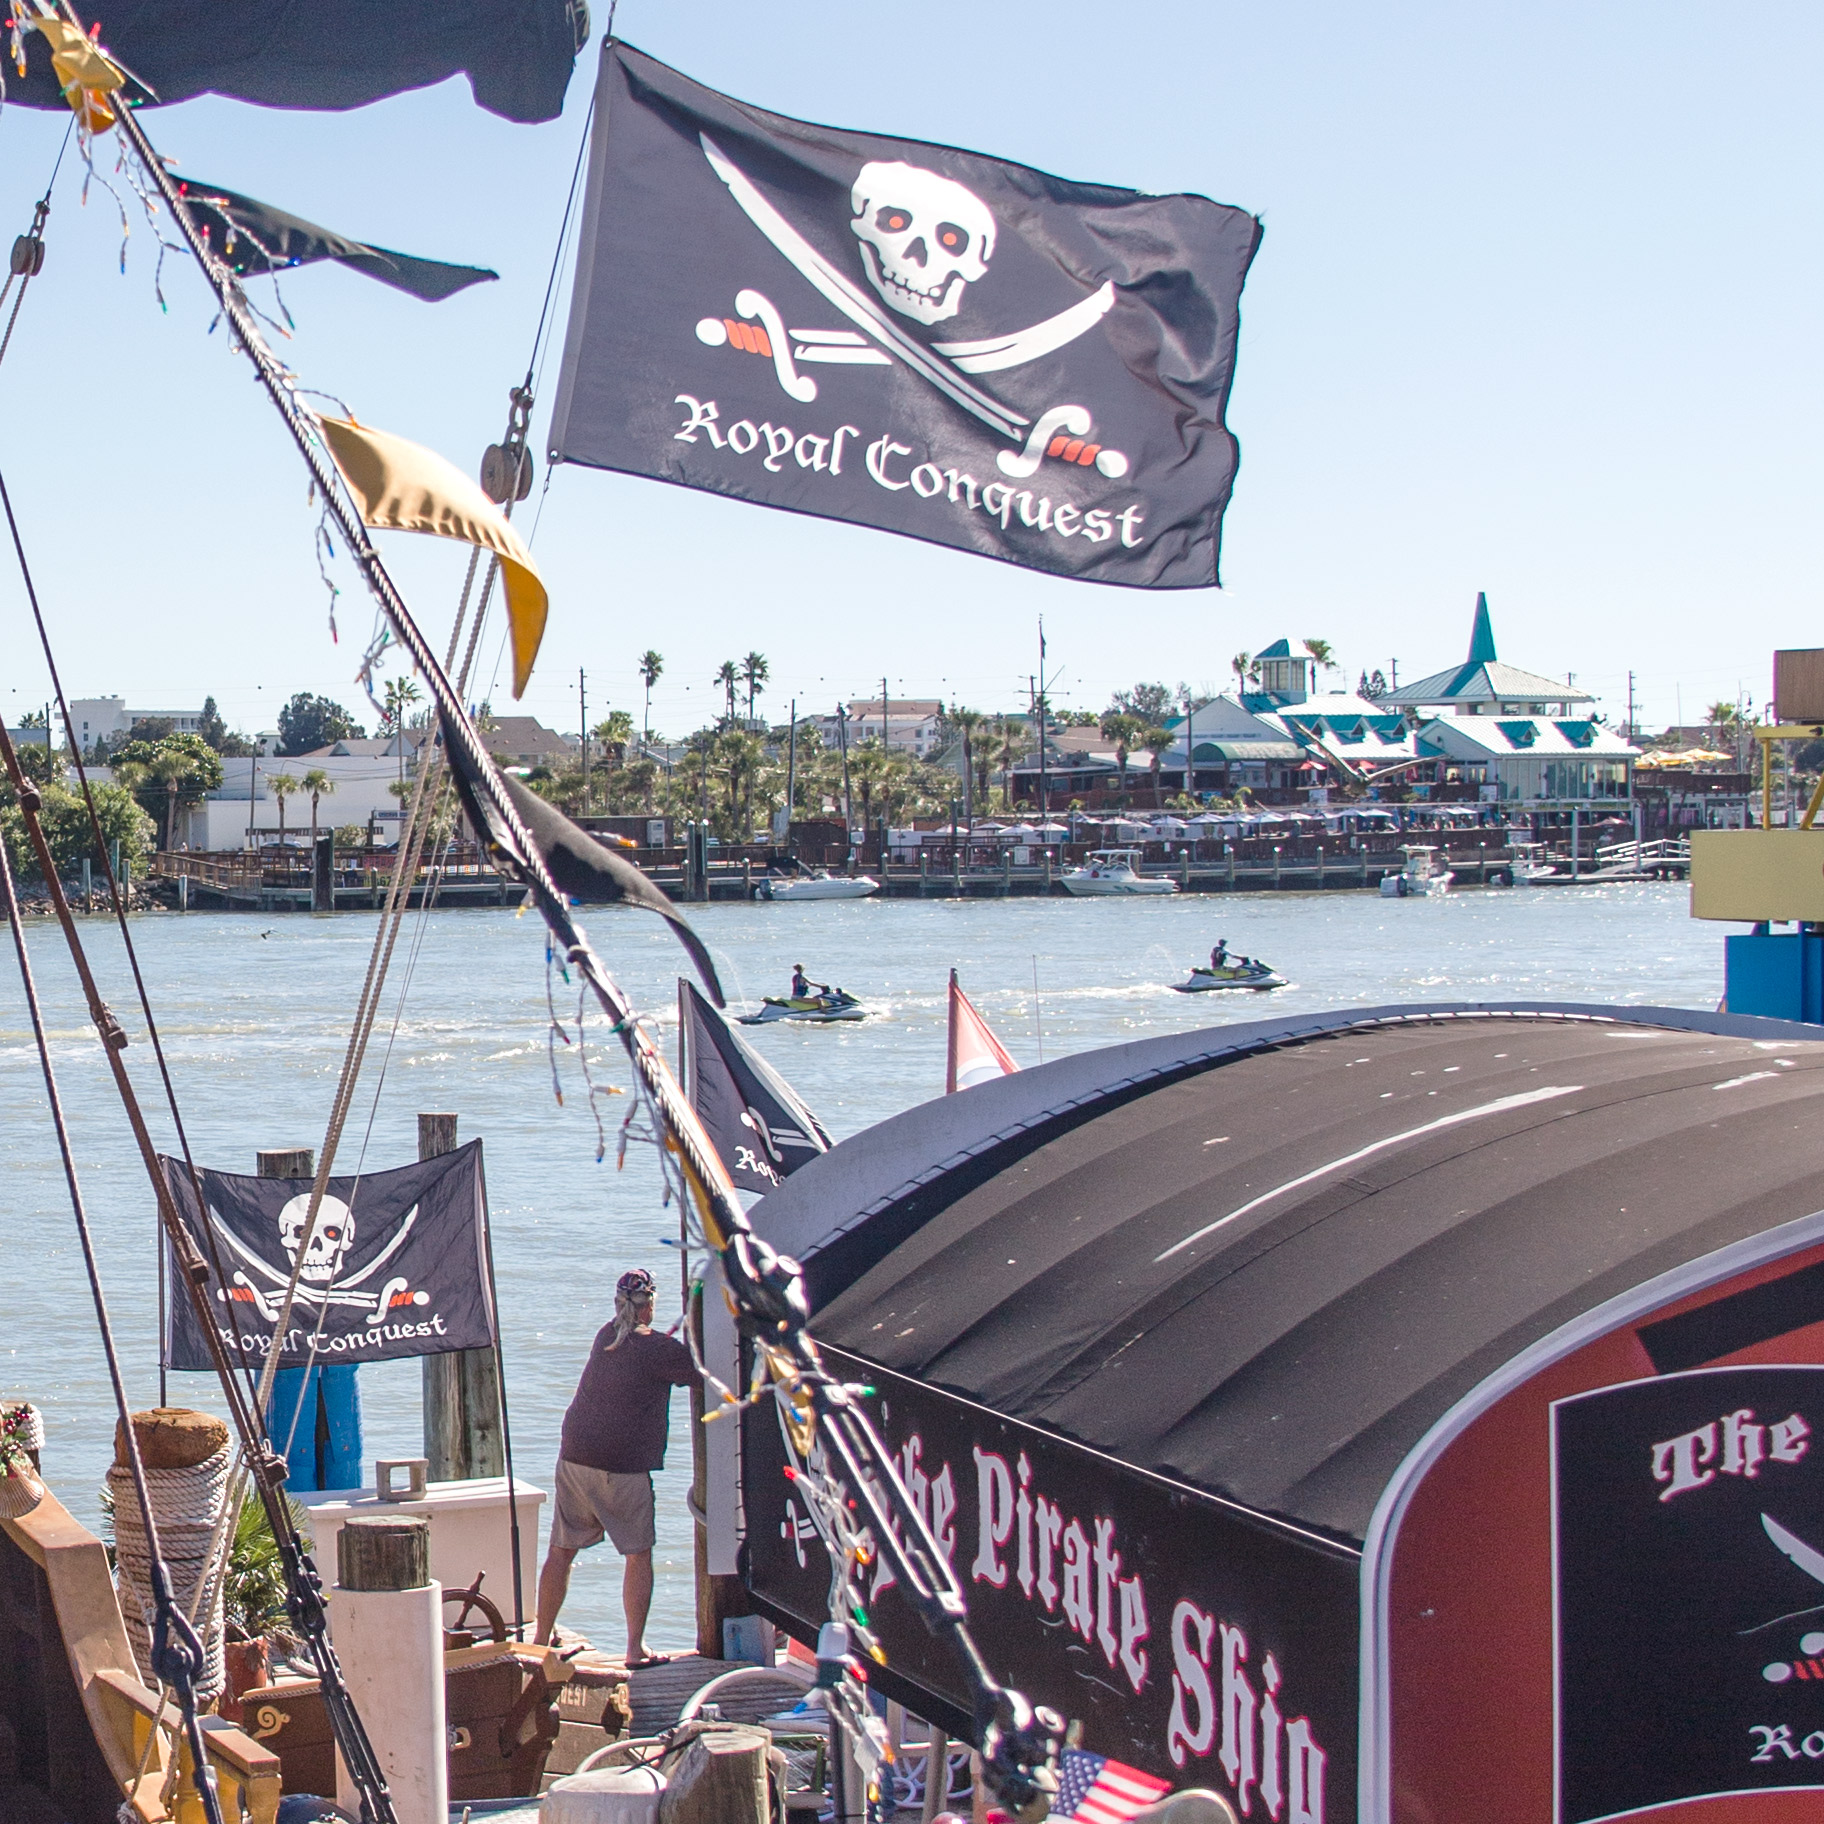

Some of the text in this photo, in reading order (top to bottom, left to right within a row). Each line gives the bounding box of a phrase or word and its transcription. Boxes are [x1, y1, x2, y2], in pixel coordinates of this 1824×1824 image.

[673, 394, 1144, 550] Royal Conquest
[307, 1313, 447, 1354] Conquest
[1650, 1408, 1813, 1503] The
[972, 1445, 1150, 1693] Pirate
